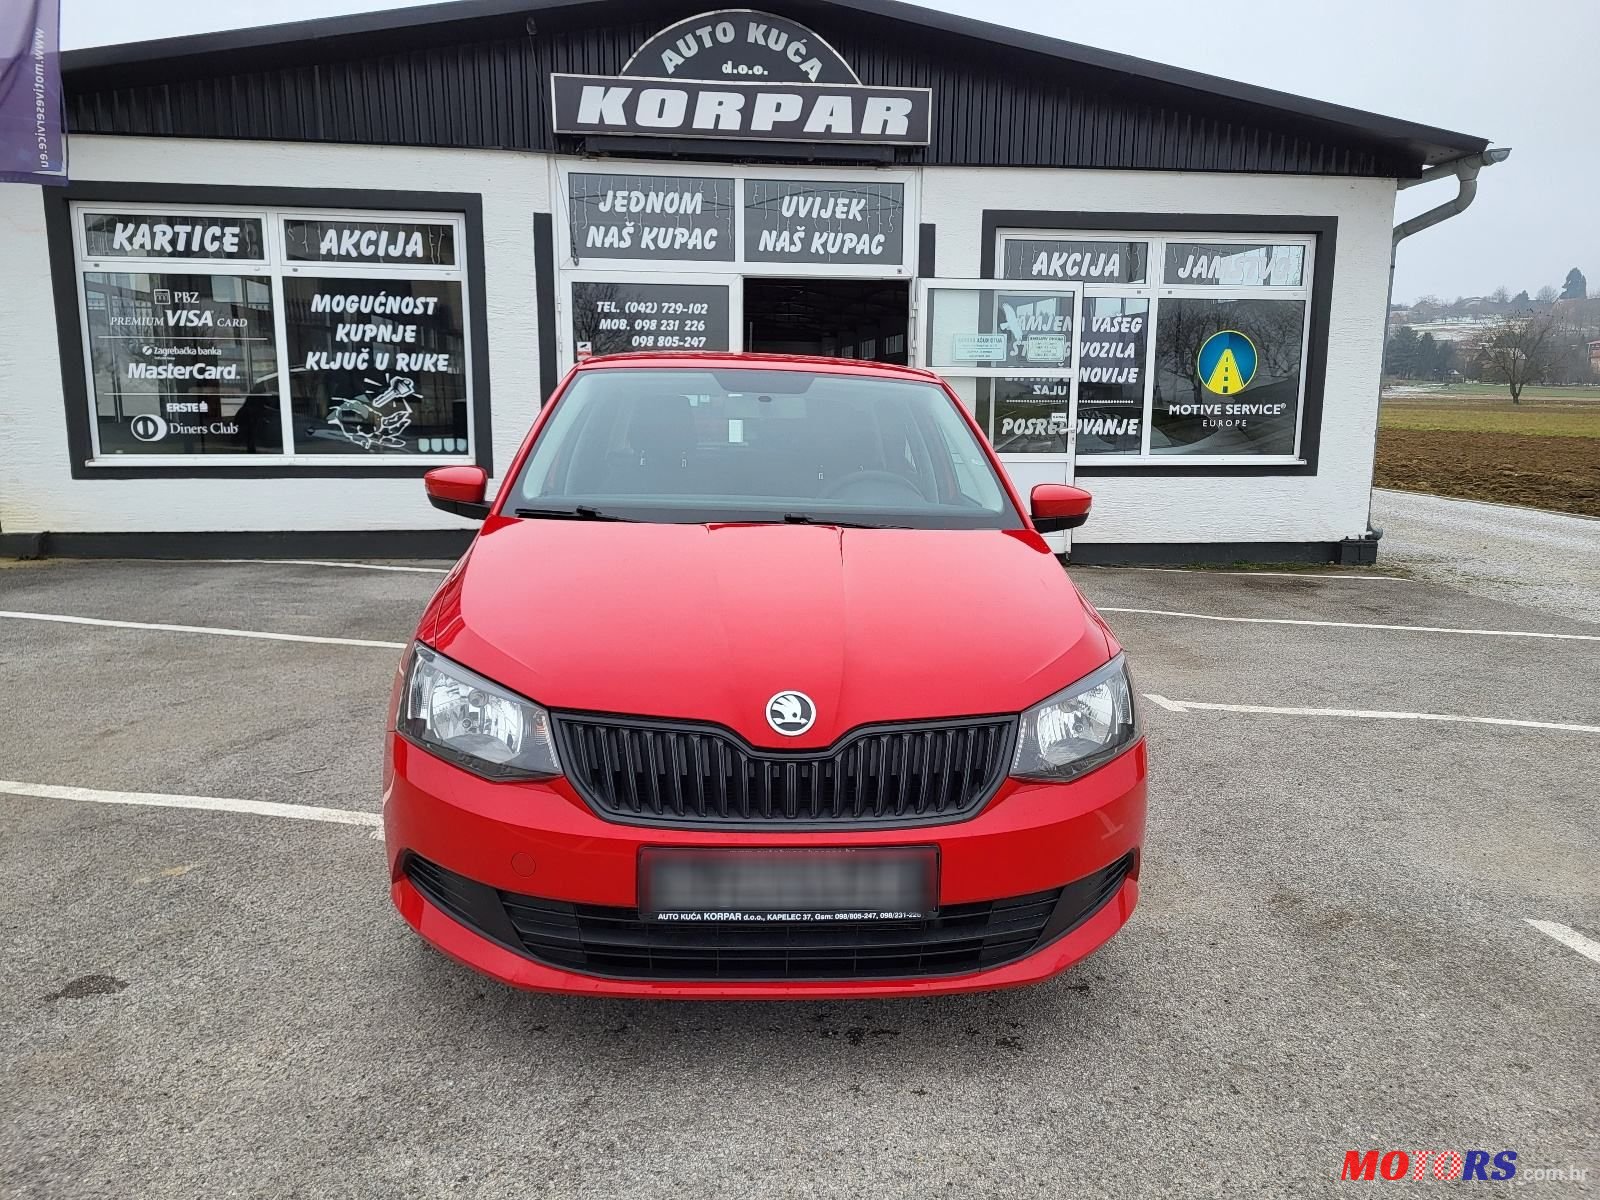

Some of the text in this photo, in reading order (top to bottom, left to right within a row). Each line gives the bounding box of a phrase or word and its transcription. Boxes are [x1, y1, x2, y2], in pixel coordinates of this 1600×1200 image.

[660, 22, 823, 82] AUTO KUĆA
[721, 61, 768, 75] d.o.o.
[577, 85, 913, 135] KORPAR
[598, 190, 703, 214] JEDNOM
[781, 196, 866, 222] UVIJEK
[112, 222, 241, 253] KARTICE
[319, 229, 424, 258] AKCIJA
[586, 221, 718, 250] NAŠ KUPAC
[758, 226, 886, 255] NAŠ KUPAC
[1031, 252, 1120, 277] AKCIJA
[174, 291, 200, 304] PBZ
[310, 290, 438, 316] MOGUĆNOST
[597, 301, 708, 315] TEL. (042) 729-102
[110, 310, 248, 327] PREMIUM VISA CARD
[599, 318, 706, 331] MOB. 098 231 226
[1012, 313, 1143, 333] AMJEN VAŠEG
[335, 323, 416, 343] KUPNJE
[631, 335, 706, 348] 098 805-247
[153, 346, 222, 357] Zagrebačka banka
[1080, 342, 1135, 358] VOZILA
[306, 347, 449, 372] KLJUČ U RUKE
[1079, 367, 1139, 383] NOVIJE
[166, 402, 199, 413] ERSTE
[1168, 404, 1221, 415] MOTIVE
[170, 423, 238, 434] Diners Club
[680, 912, 701, 920] KUĆA
